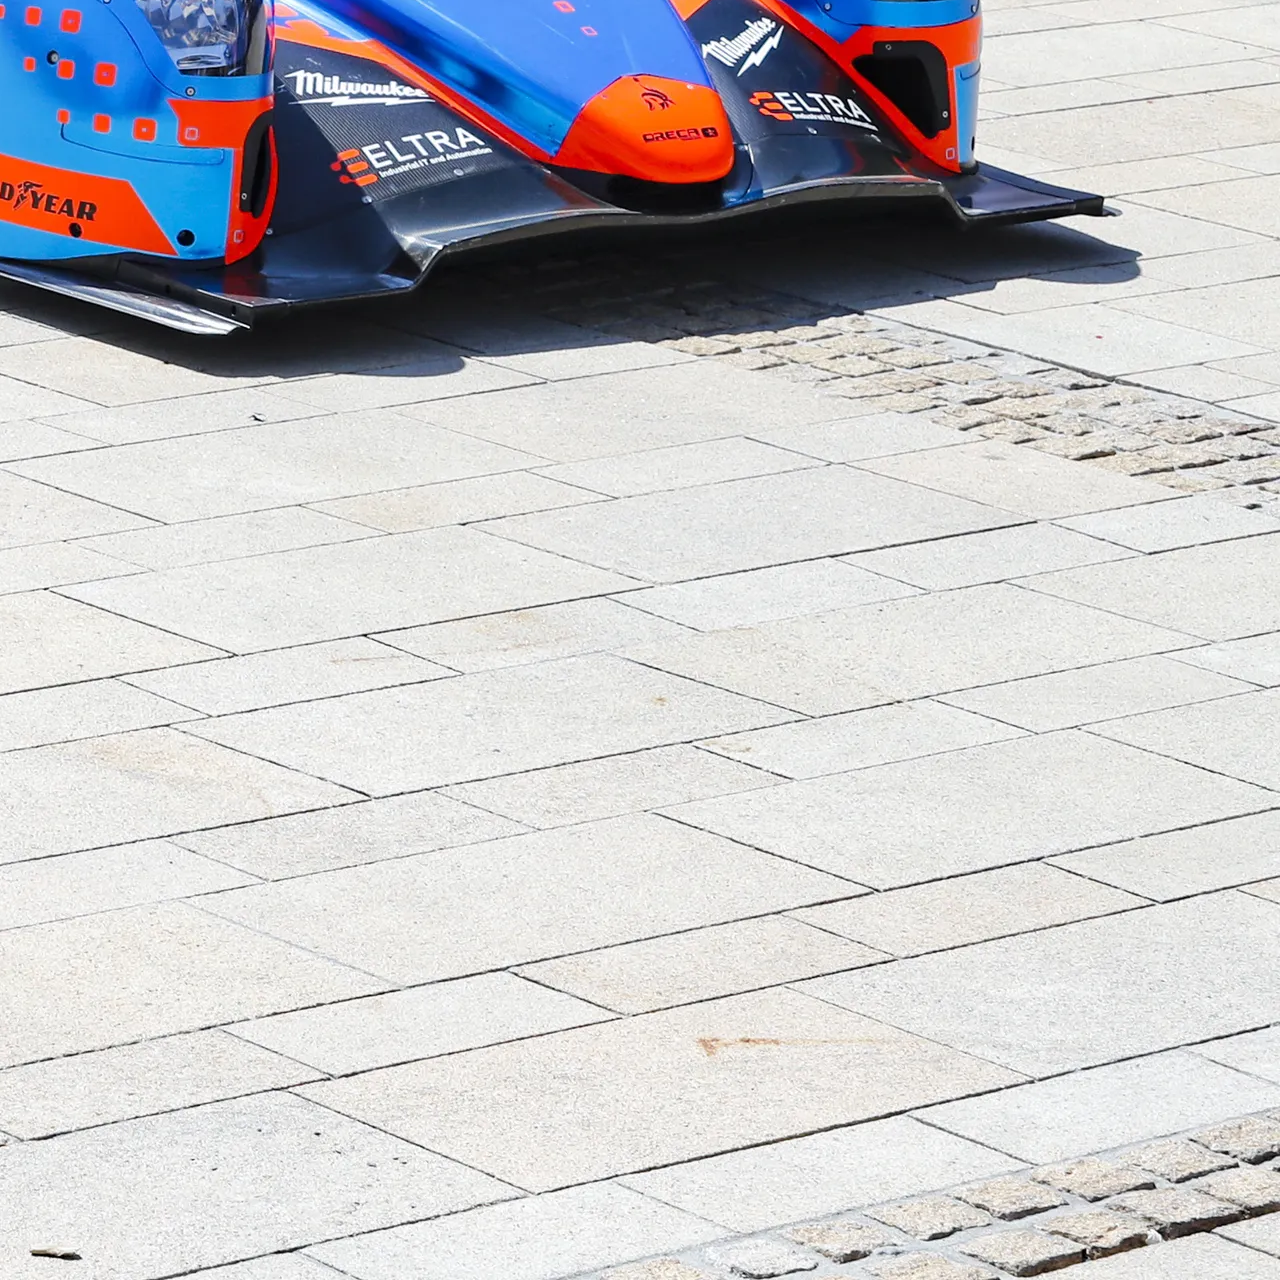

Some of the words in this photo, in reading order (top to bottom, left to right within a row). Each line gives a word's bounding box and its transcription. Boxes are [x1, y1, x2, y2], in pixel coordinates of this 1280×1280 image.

[702, 16, 776, 67] Milwaukee
[284, 69, 430, 97] Milwaukee
[772, 92, 872, 124] ELTRA
[361, 127, 486, 169] ELTRA
[642, 128, 700, 143] ORECA
[378, 158, 422, 178] Industrial
[430, 155, 445, 165] and
[446, 147, 493, 162] Automation
